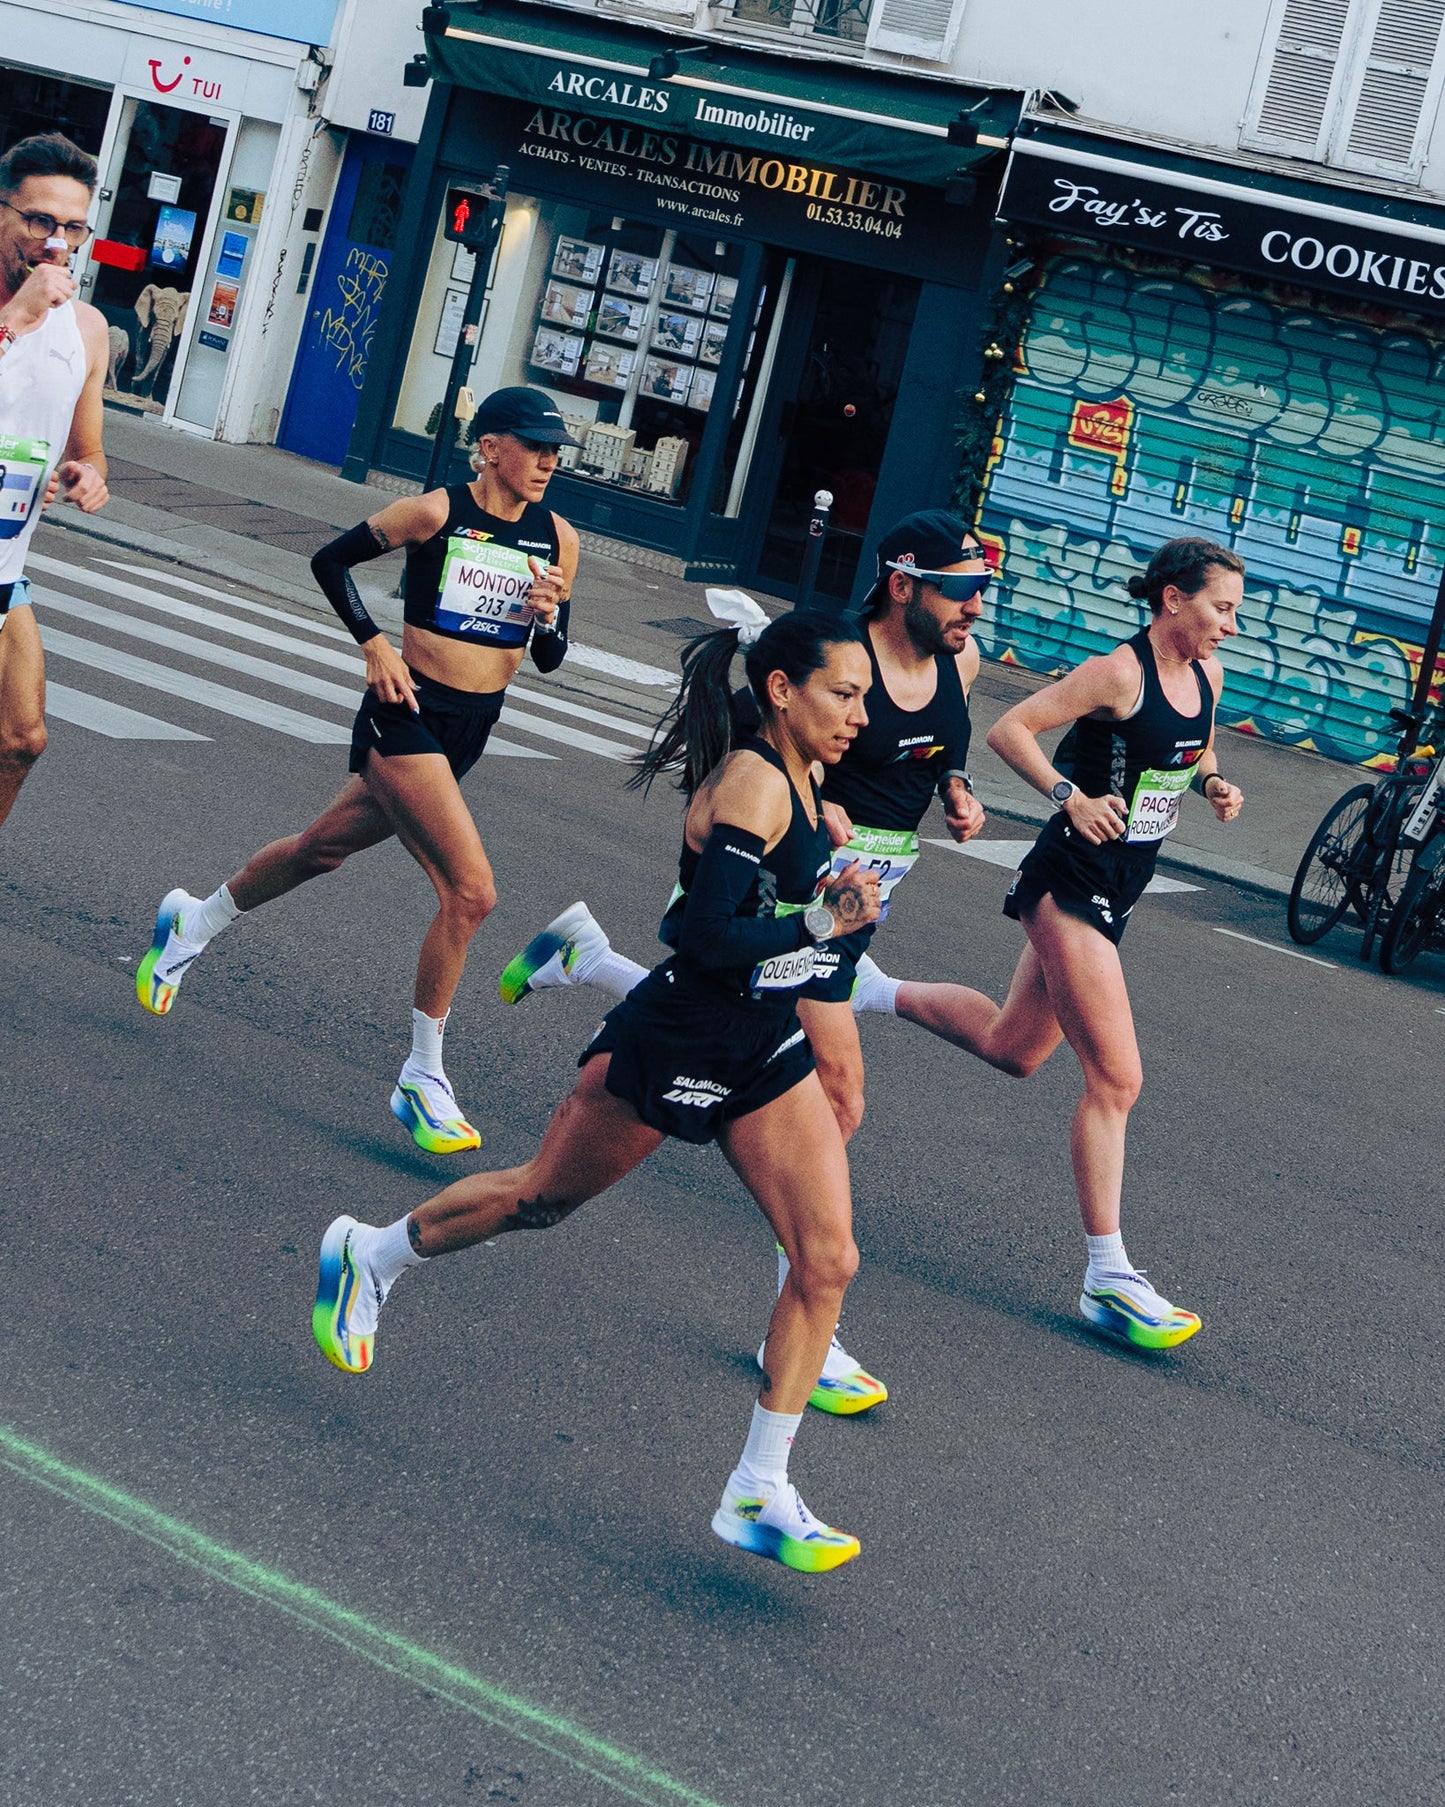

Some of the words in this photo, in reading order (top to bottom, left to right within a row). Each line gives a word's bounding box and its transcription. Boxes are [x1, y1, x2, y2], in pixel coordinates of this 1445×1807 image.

[192, 77, 222, 100] TUI
[547, 70, 670, 113] ARCALES
[694, 97, 815, 142] Immobilier
[371, 112, 393, 132] 181
[518, 143, 569, 164] ACHATS
[578, 155, 626, 178] VENTES
[636, 169, 741, 203] TRANSACTIONS
[524, 107, 679, 166] ARCALES
[685, 145, 907, 217] IMMOBILIER
[656, 197, 744, 227] www.arcales.fr
[806, 202, 903, 240] 01.53.33.04.04
[1175, 207, 1230, 242] Tis
[1261, 229, 1445, 299] COOKIES
[462, 540, 522, 563] Schneider
[517, 539, 551, 550] SALOMON
[474, 595, 505, 616] 213
[898, 735, 934, 748] SALOMON
[851, 827, 906, 846] Schneider
[672, 1075, 733, 1096] SALOMON
